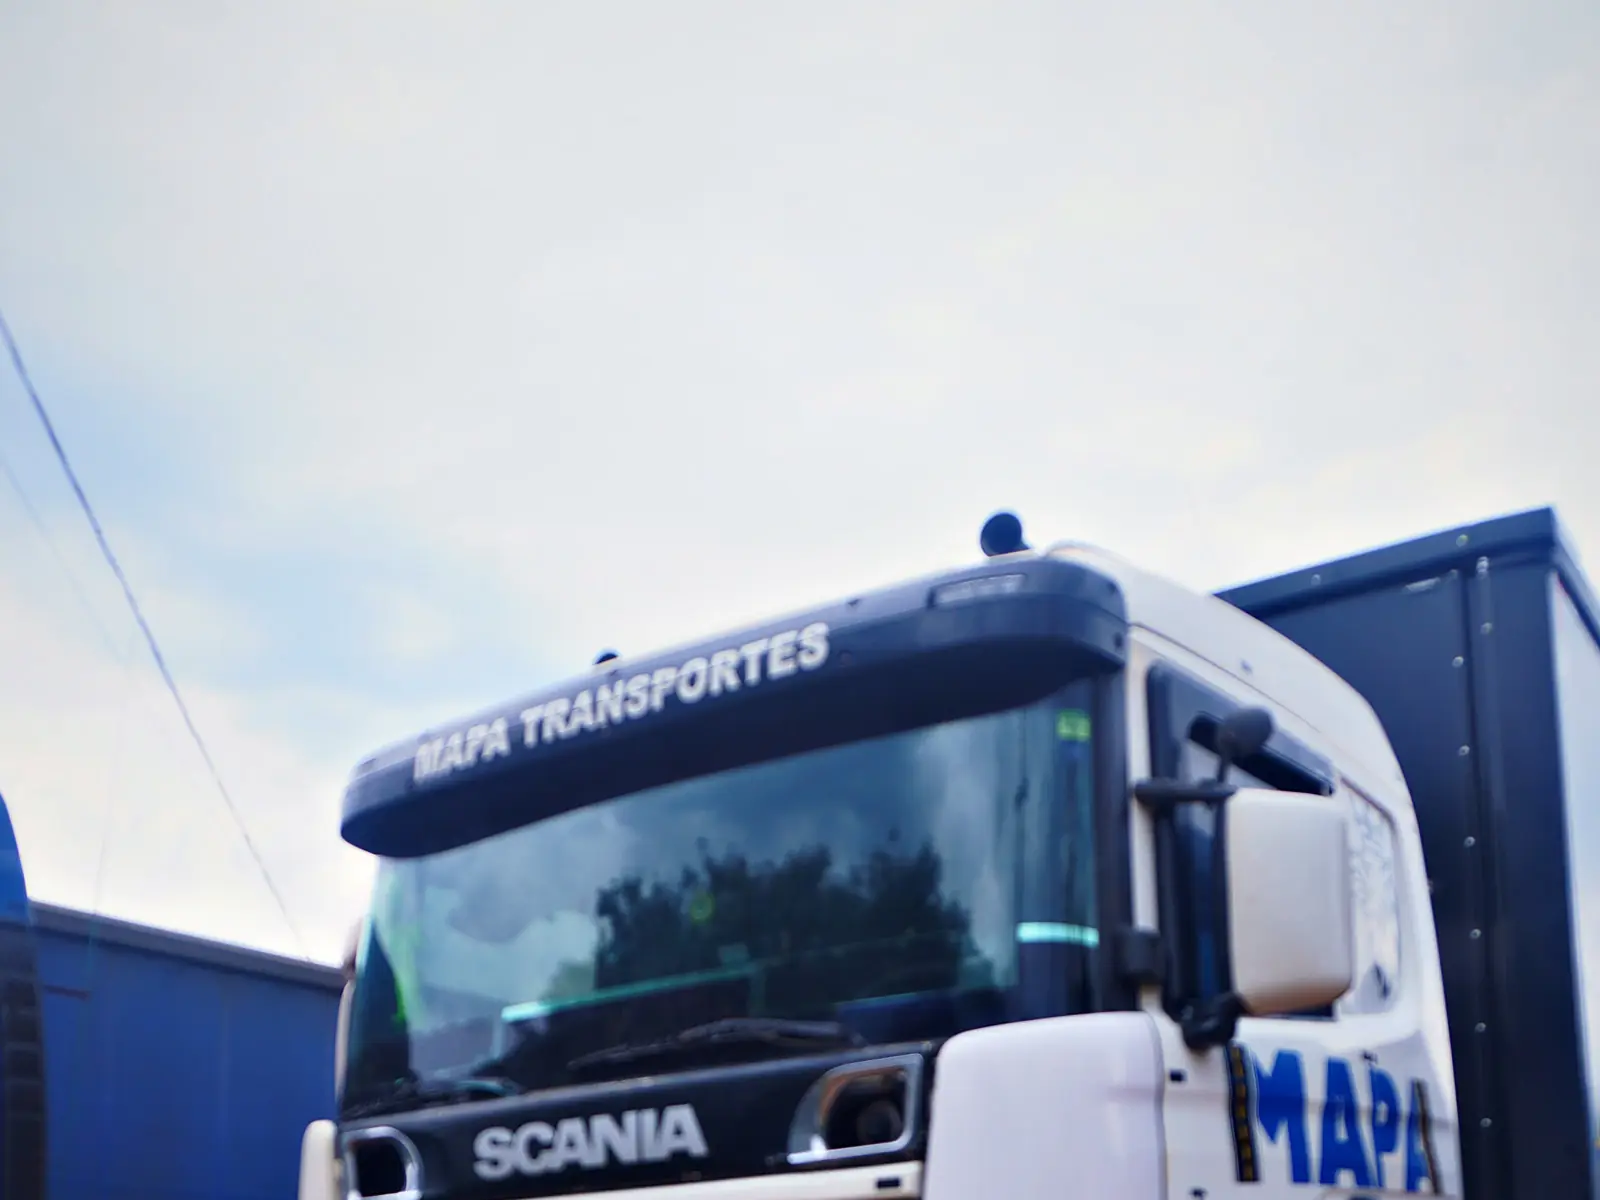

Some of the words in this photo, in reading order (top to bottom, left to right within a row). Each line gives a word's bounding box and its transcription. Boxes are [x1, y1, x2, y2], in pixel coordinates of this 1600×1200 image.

[413, 716, 510, 785] MAPA
[519, 621, 830, 747] TRANSPORTES
[473, 1103, 708, 1182] SCANIA
